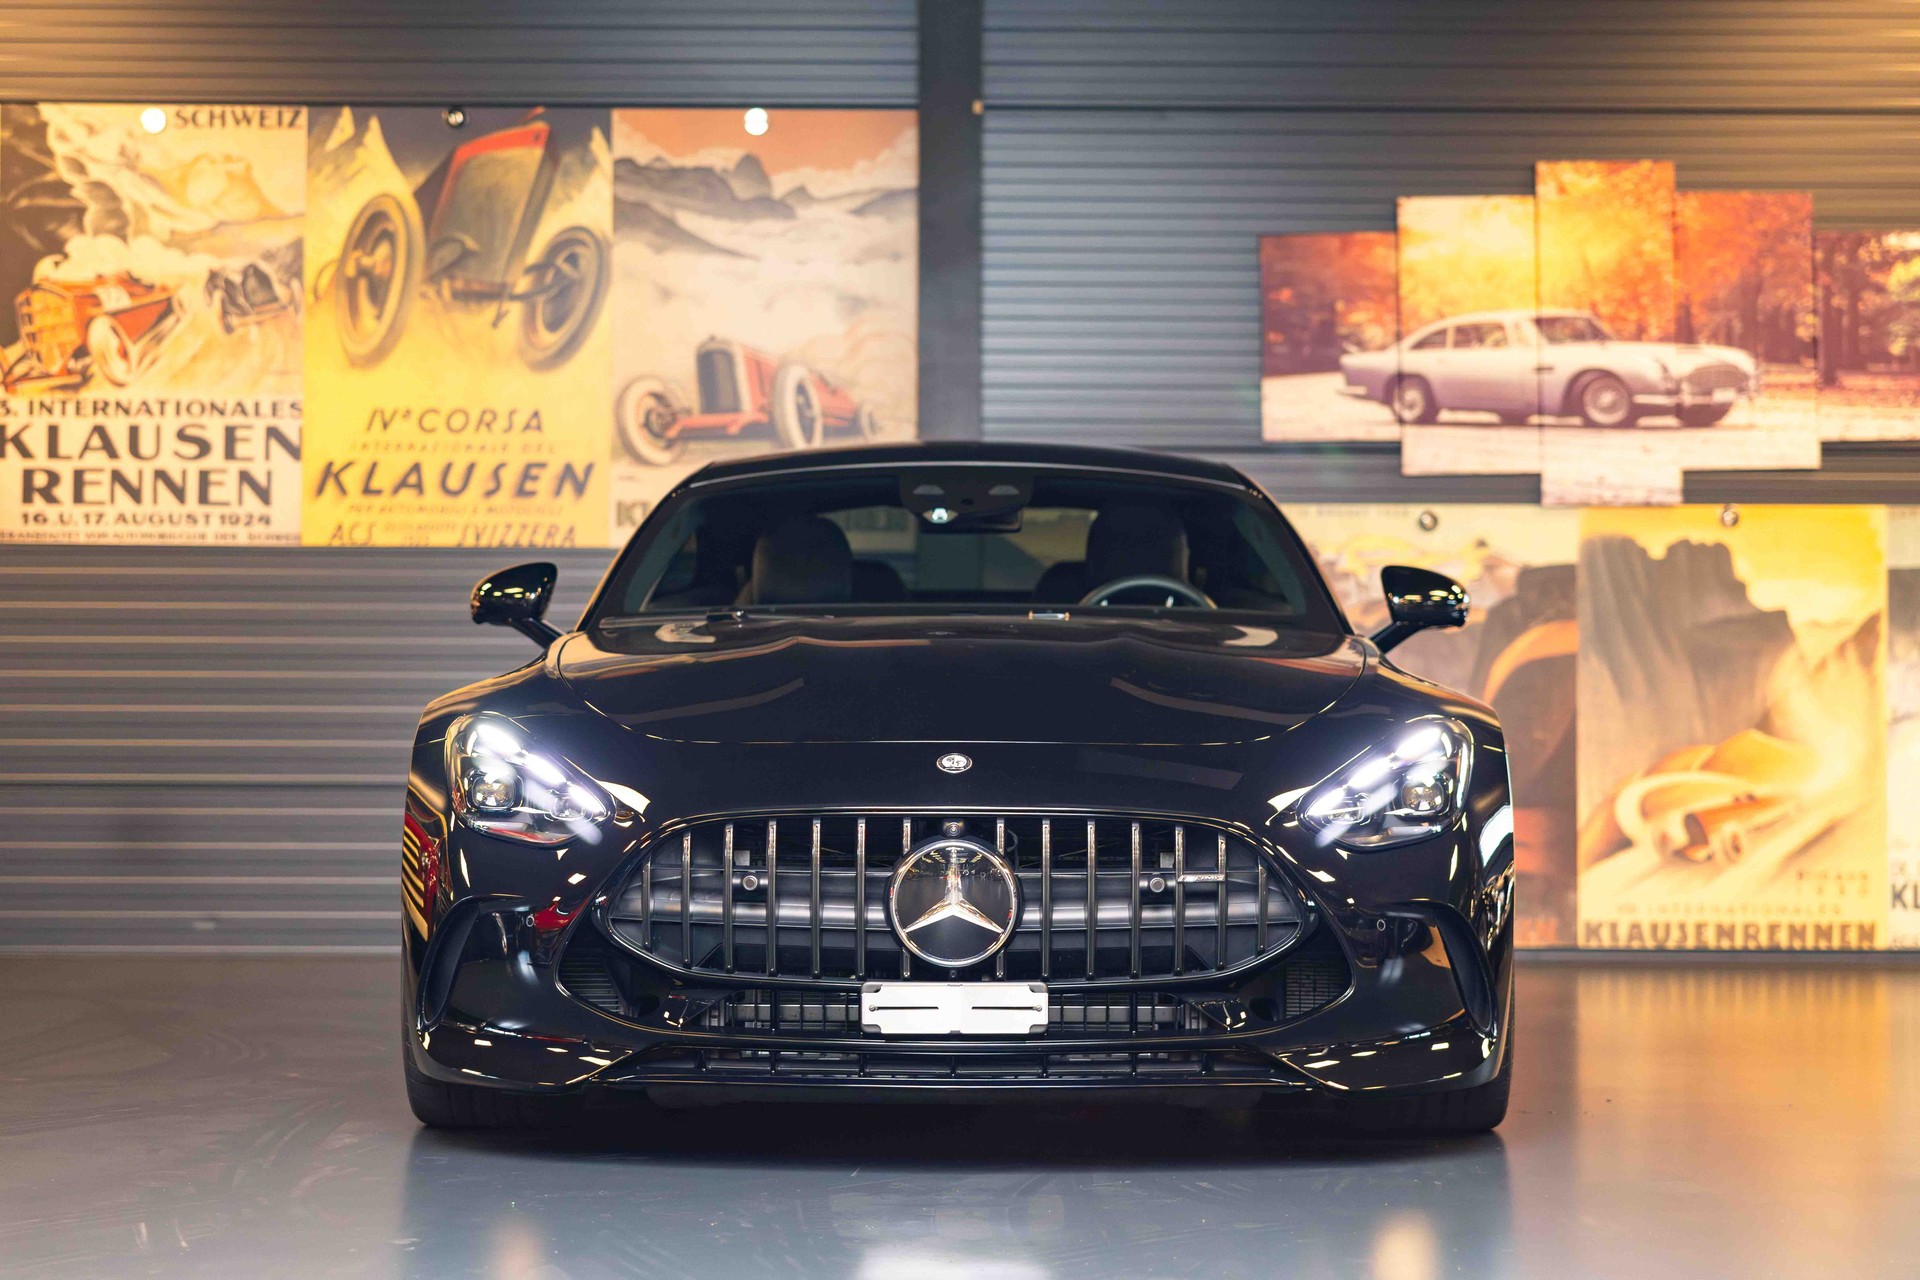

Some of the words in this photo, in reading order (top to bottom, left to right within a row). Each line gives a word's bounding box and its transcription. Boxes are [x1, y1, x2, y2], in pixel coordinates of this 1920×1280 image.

[175, 109, 302, 129] SCHWEIZ
[29, 400, 303, 418] INTERNATIONALES
[418, 409, 543, 433] CORSA
[0, 424, 303, 461] KLAUSEN
[22, 468, 272, 506] RENNEN
[315, 461, 595, 497] KLAUSEN
[115, 512, 211, 526] AUGUST
[219, 513, 271, 527] 1924
[455, 523, 576, 548] SVIZZERA
[1584, 920, 1876, 949] KLAUSENRENNEN
